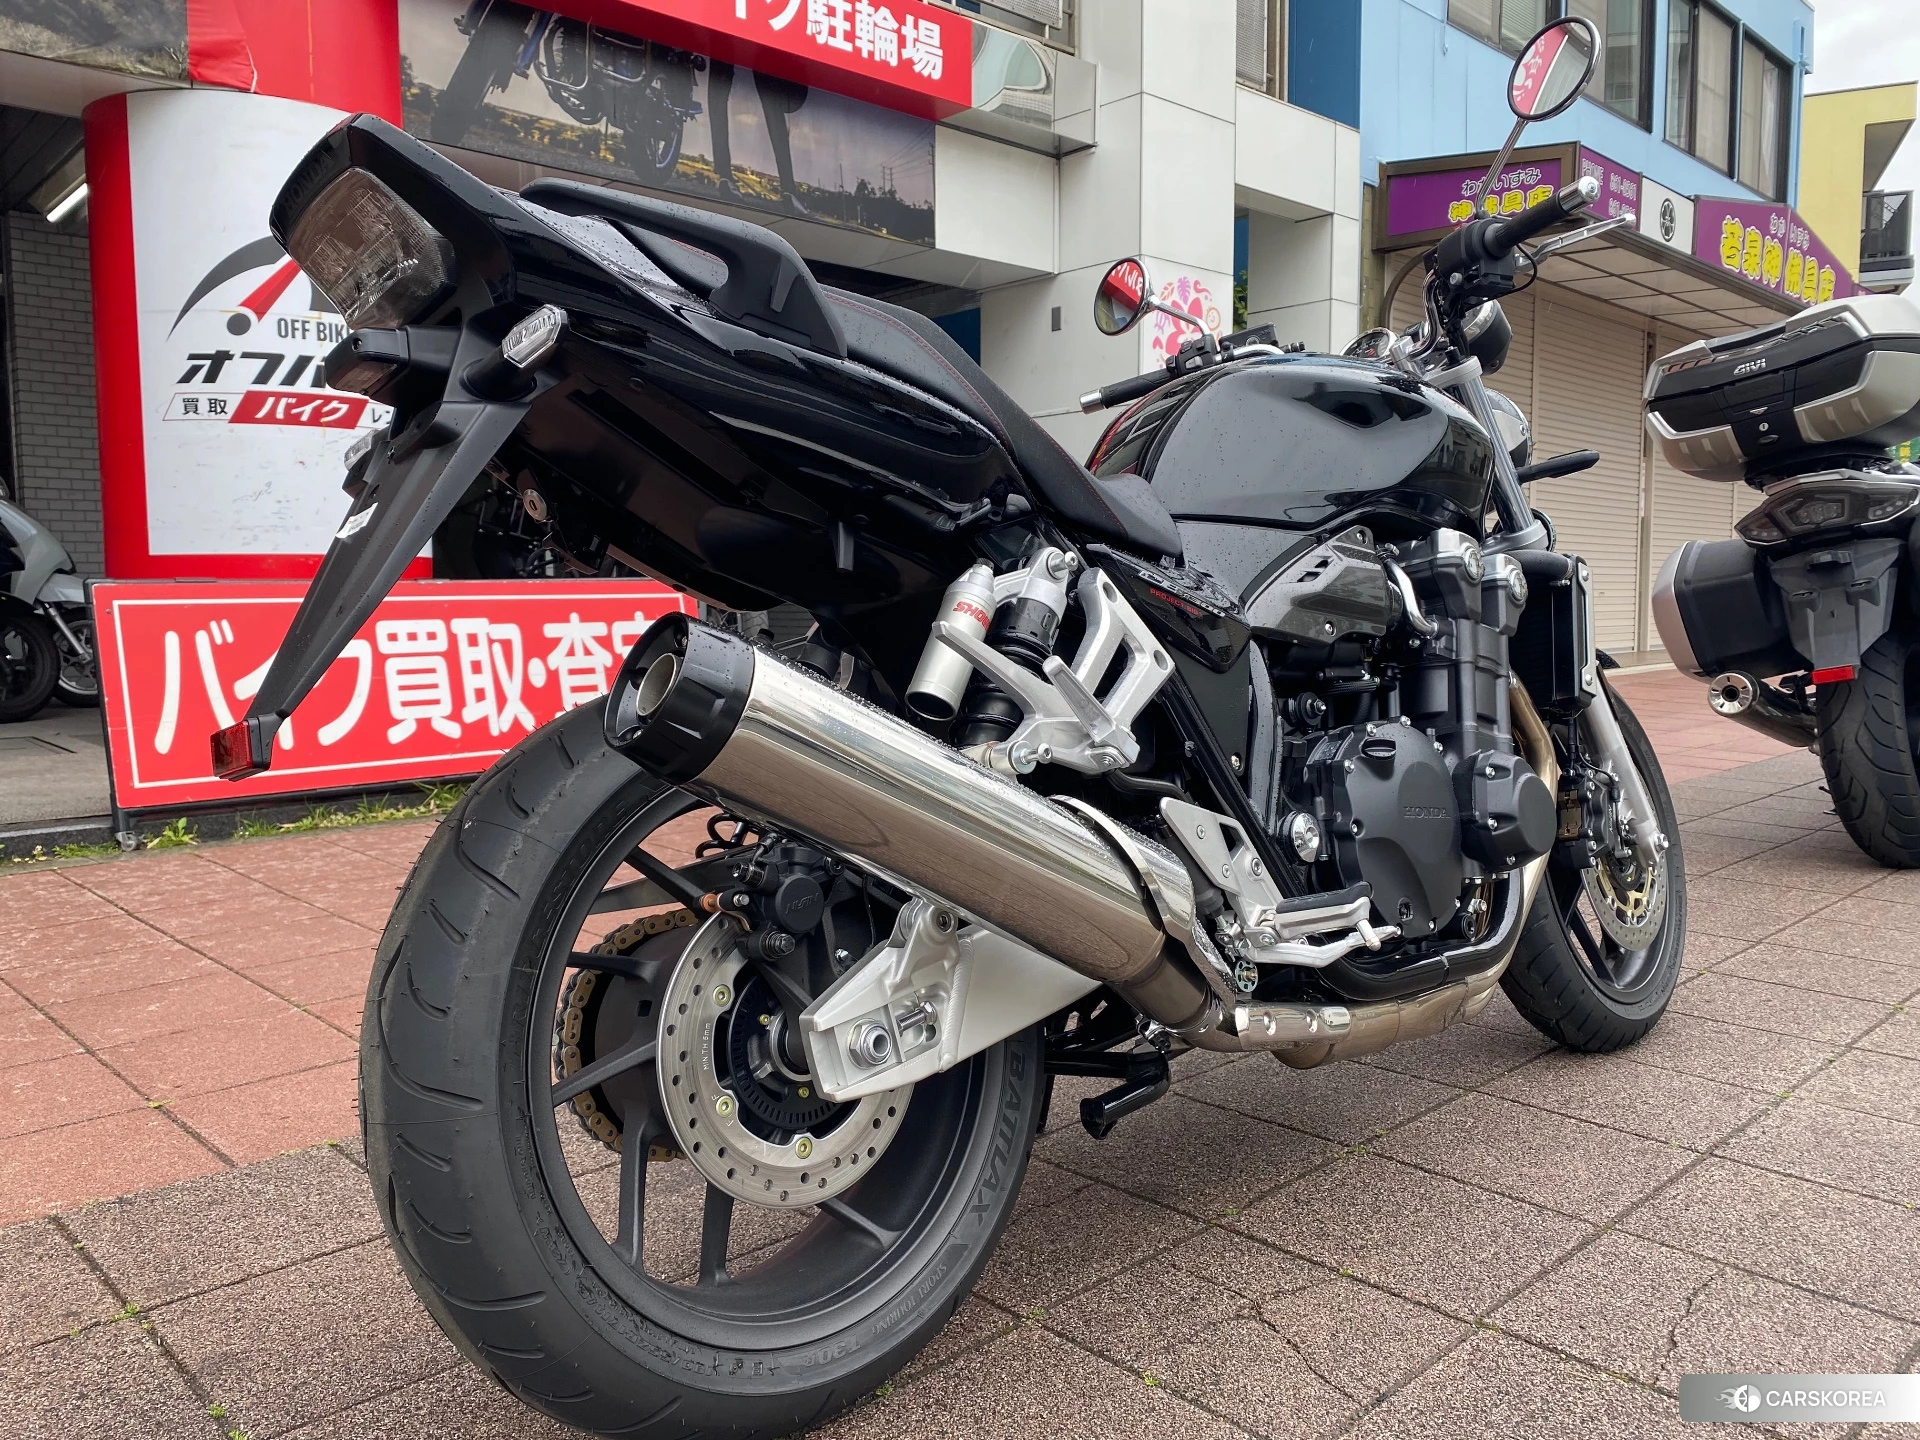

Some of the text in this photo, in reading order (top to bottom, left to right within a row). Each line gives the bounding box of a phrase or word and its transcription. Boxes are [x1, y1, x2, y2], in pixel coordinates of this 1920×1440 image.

[277, 317, 352, 344] OFF BIK
[1733, 357, 1767, 376] GIVI
[182, 397, 229, 416] 買取
[254, 396, 351, 423] バイク
[1402, 805, 1452, 820] HONDA
[968, 1050, 1026, 1228] BATTLAX
[871, 1261, 948, 1336] SPORT TOURING
